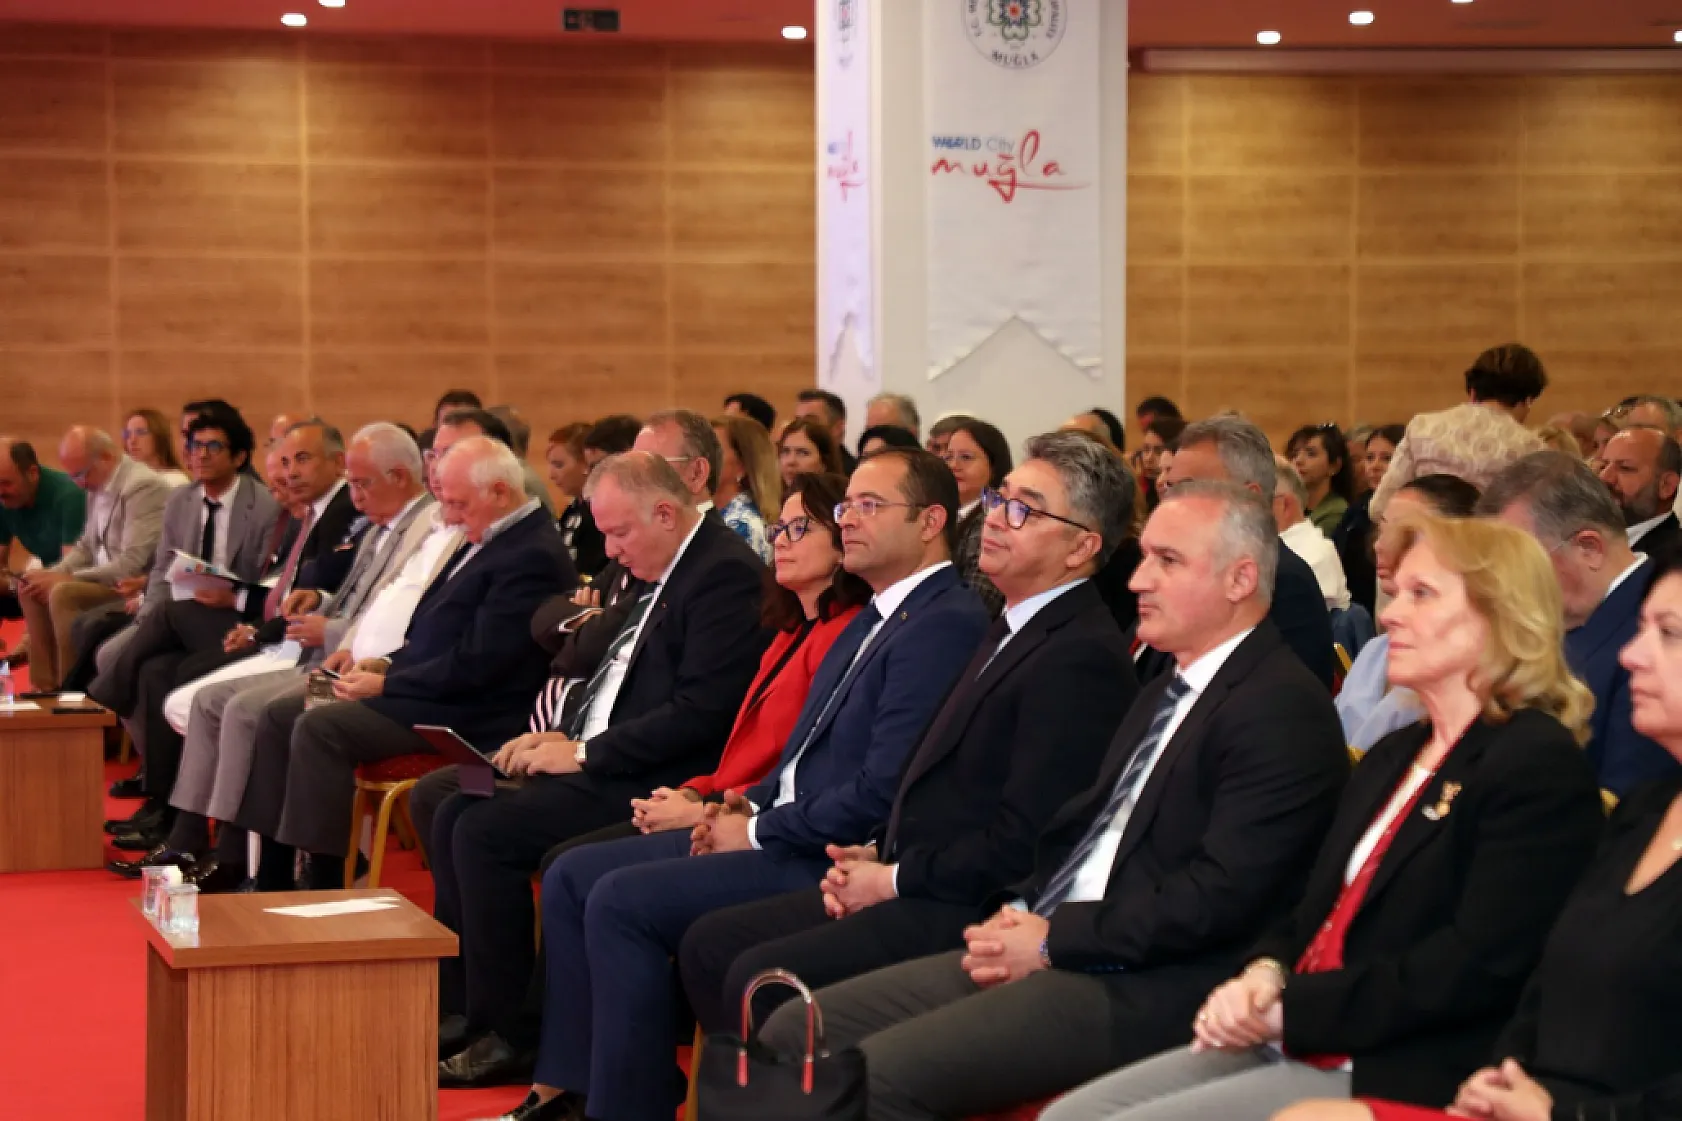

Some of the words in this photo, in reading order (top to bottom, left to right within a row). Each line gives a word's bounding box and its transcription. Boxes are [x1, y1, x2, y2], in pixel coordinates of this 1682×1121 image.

[991, 49, 1039, 66] MUĞLA
[932, 135, 982, 151] WORLD
[931, 129, 1091, 203] muğla
